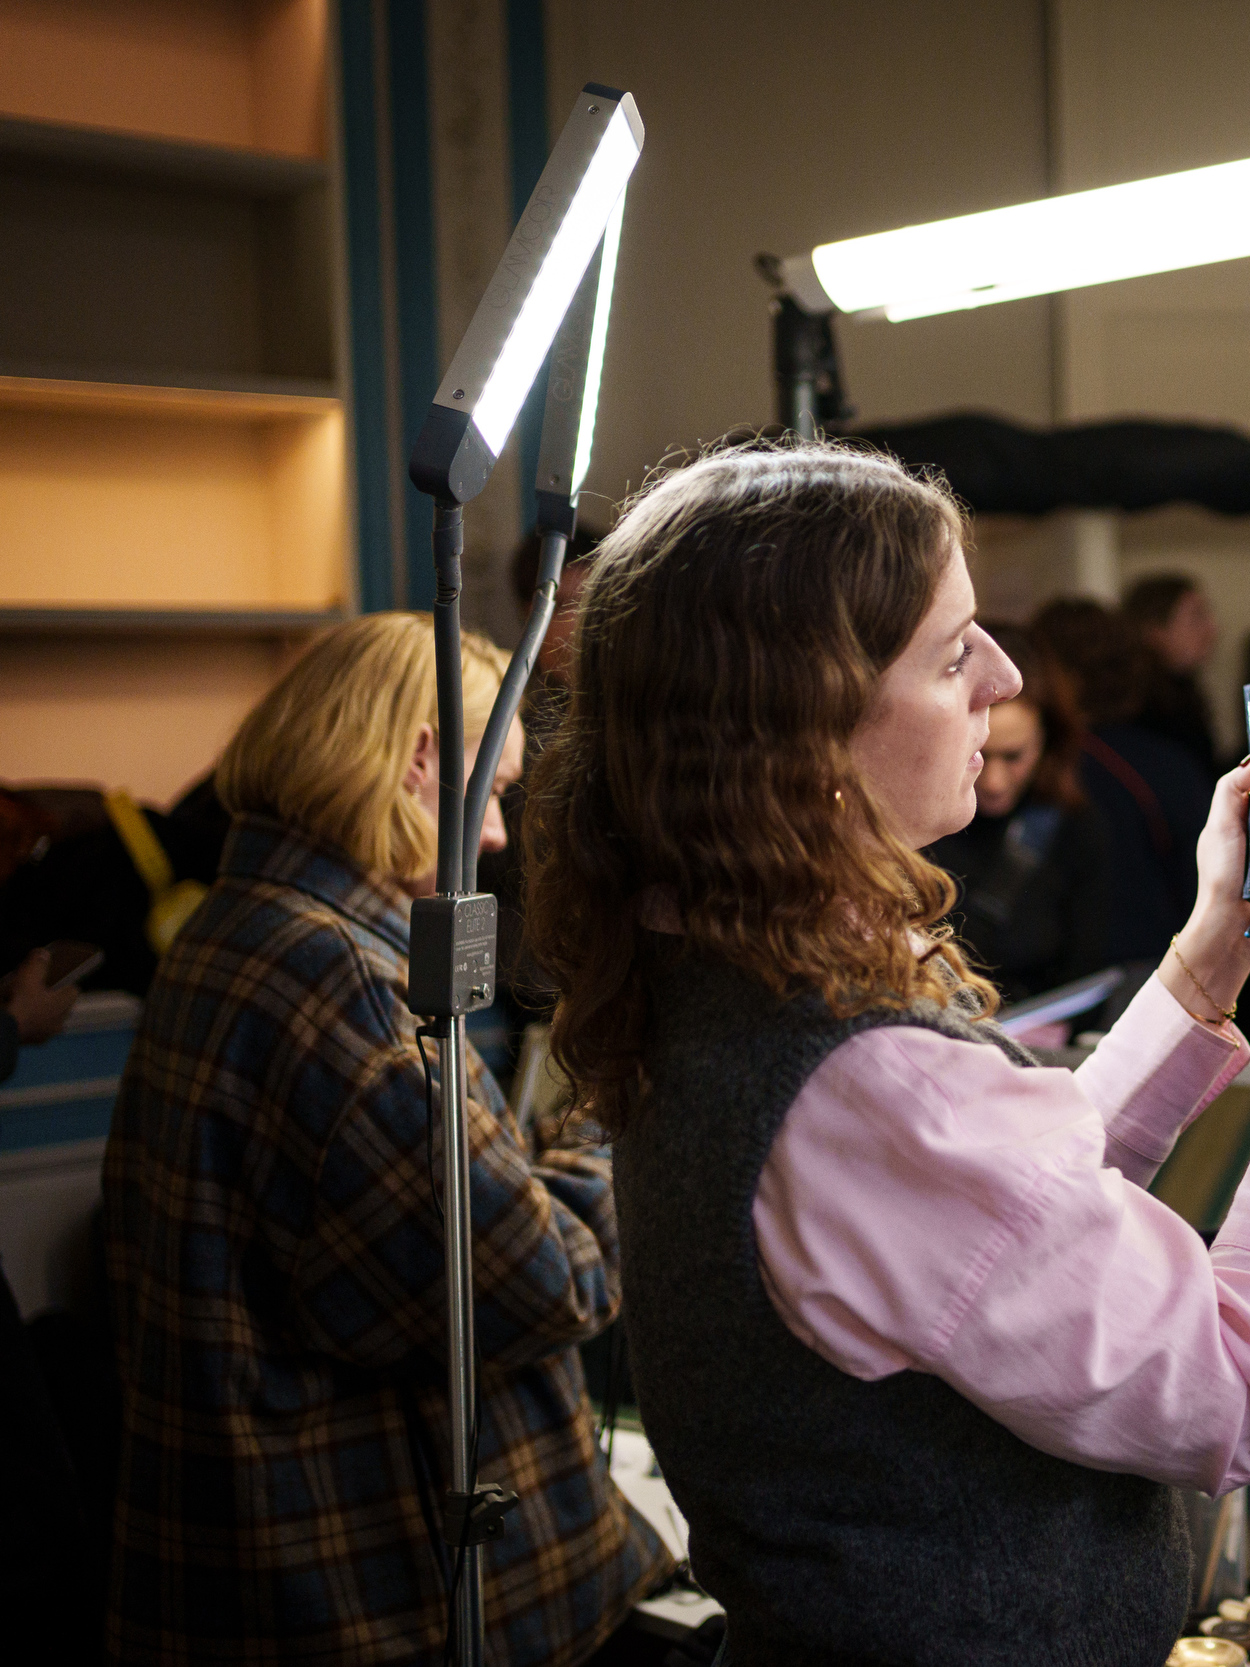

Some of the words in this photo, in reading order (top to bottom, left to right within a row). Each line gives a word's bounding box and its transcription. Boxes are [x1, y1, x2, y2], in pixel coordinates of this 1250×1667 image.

[486, 186, 557, 308] GLAMCOR
[464, 900, 489, 918] CLASSIC
[467, 917, 481, 933] ELITE
